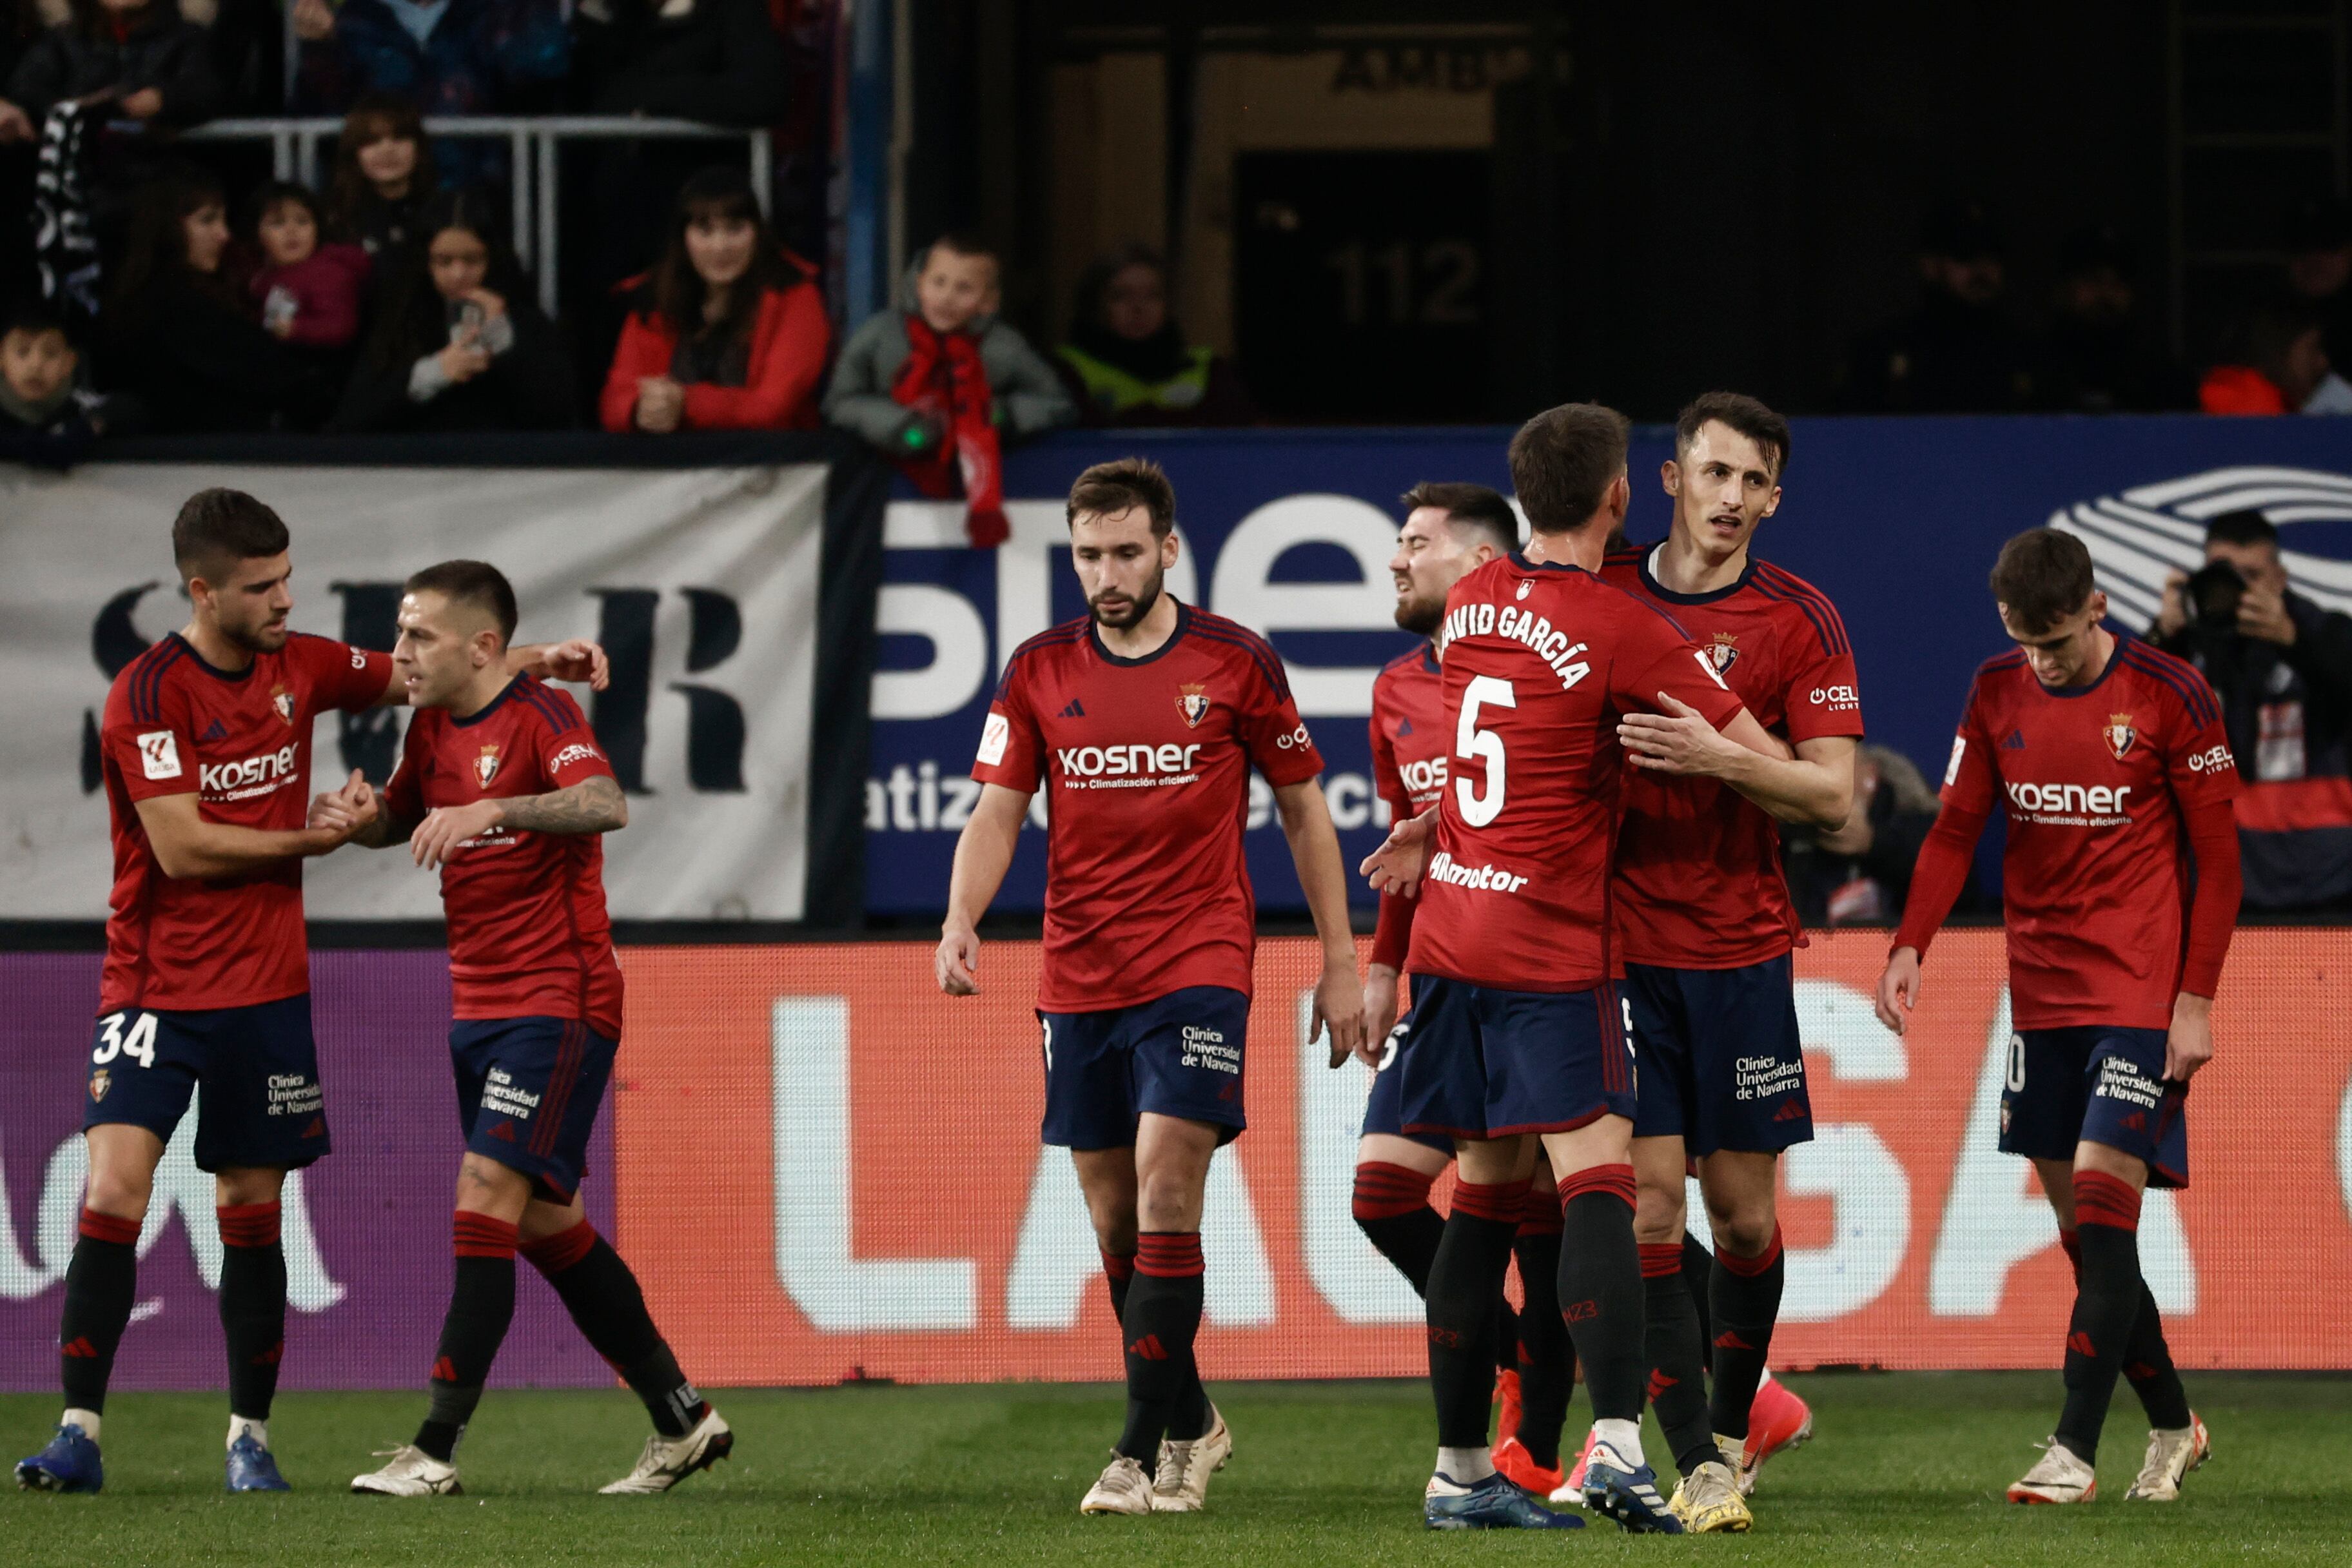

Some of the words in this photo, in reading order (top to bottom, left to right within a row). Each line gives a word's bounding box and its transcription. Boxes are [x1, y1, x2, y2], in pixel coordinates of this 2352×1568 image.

[1442, 603, 1496, 657] AVID
[1498, 605, 1591, 691] GARCÍA
[1455, 674, 1517, 828] 5
[1089, 778, 1156, 789] Climatización
[2033, 814, 2088, 827] Climatización
[2090, 816, 2132, 827] eficiente
[92, 1012, 159, 1068] 34
[1181, 1054, 1198, 1067] de
[1736, 1055, 1776, 1072] Clínica
[1736, 1059, 1803, 1086] Universidad
[1736, 1086, 1753, 1100] de
[1756, 1078, 1801, 1099] Navarra
[2101, 1069, 2164, 1097] Universidad
[268, 1102, 284, 1116] de
[2108, 1084, 2156, 1110] Navarra
